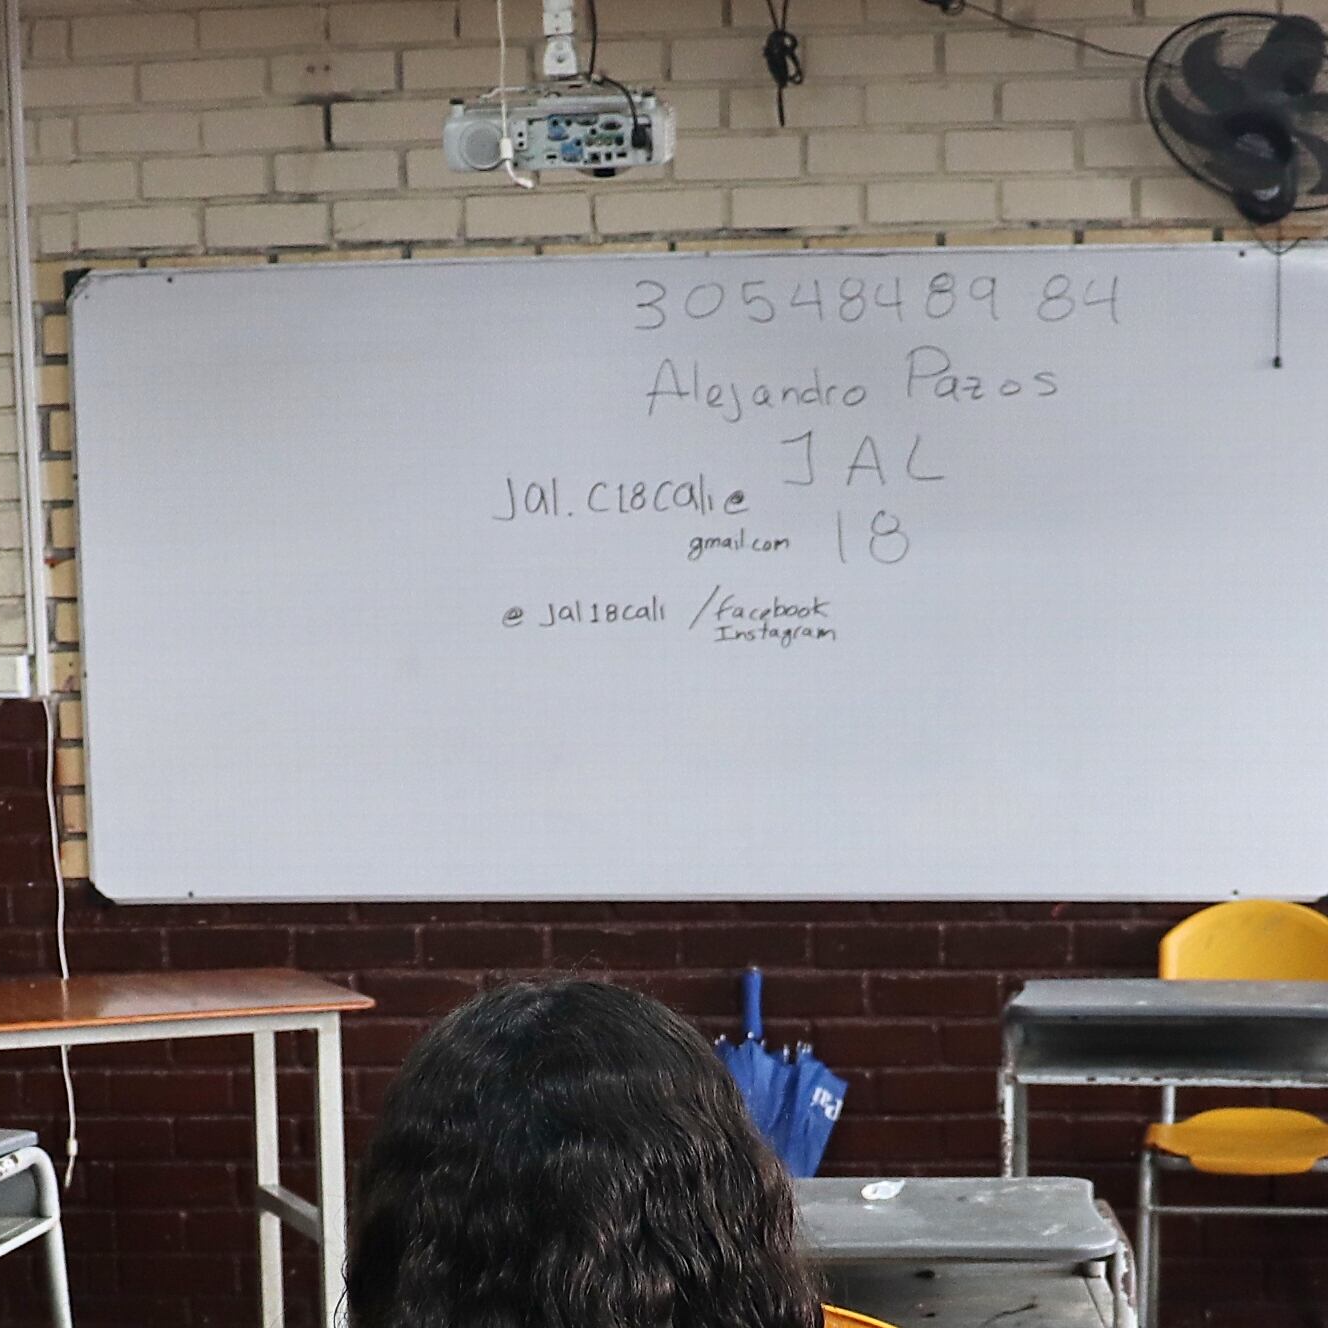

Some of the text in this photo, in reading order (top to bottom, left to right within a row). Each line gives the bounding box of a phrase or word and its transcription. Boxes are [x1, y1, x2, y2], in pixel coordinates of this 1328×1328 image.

[646, 345, 1059, 423] Alejandro Pazos
[837, 510, 910, 565] 18
[715, 620, 837, 649] Instagram
